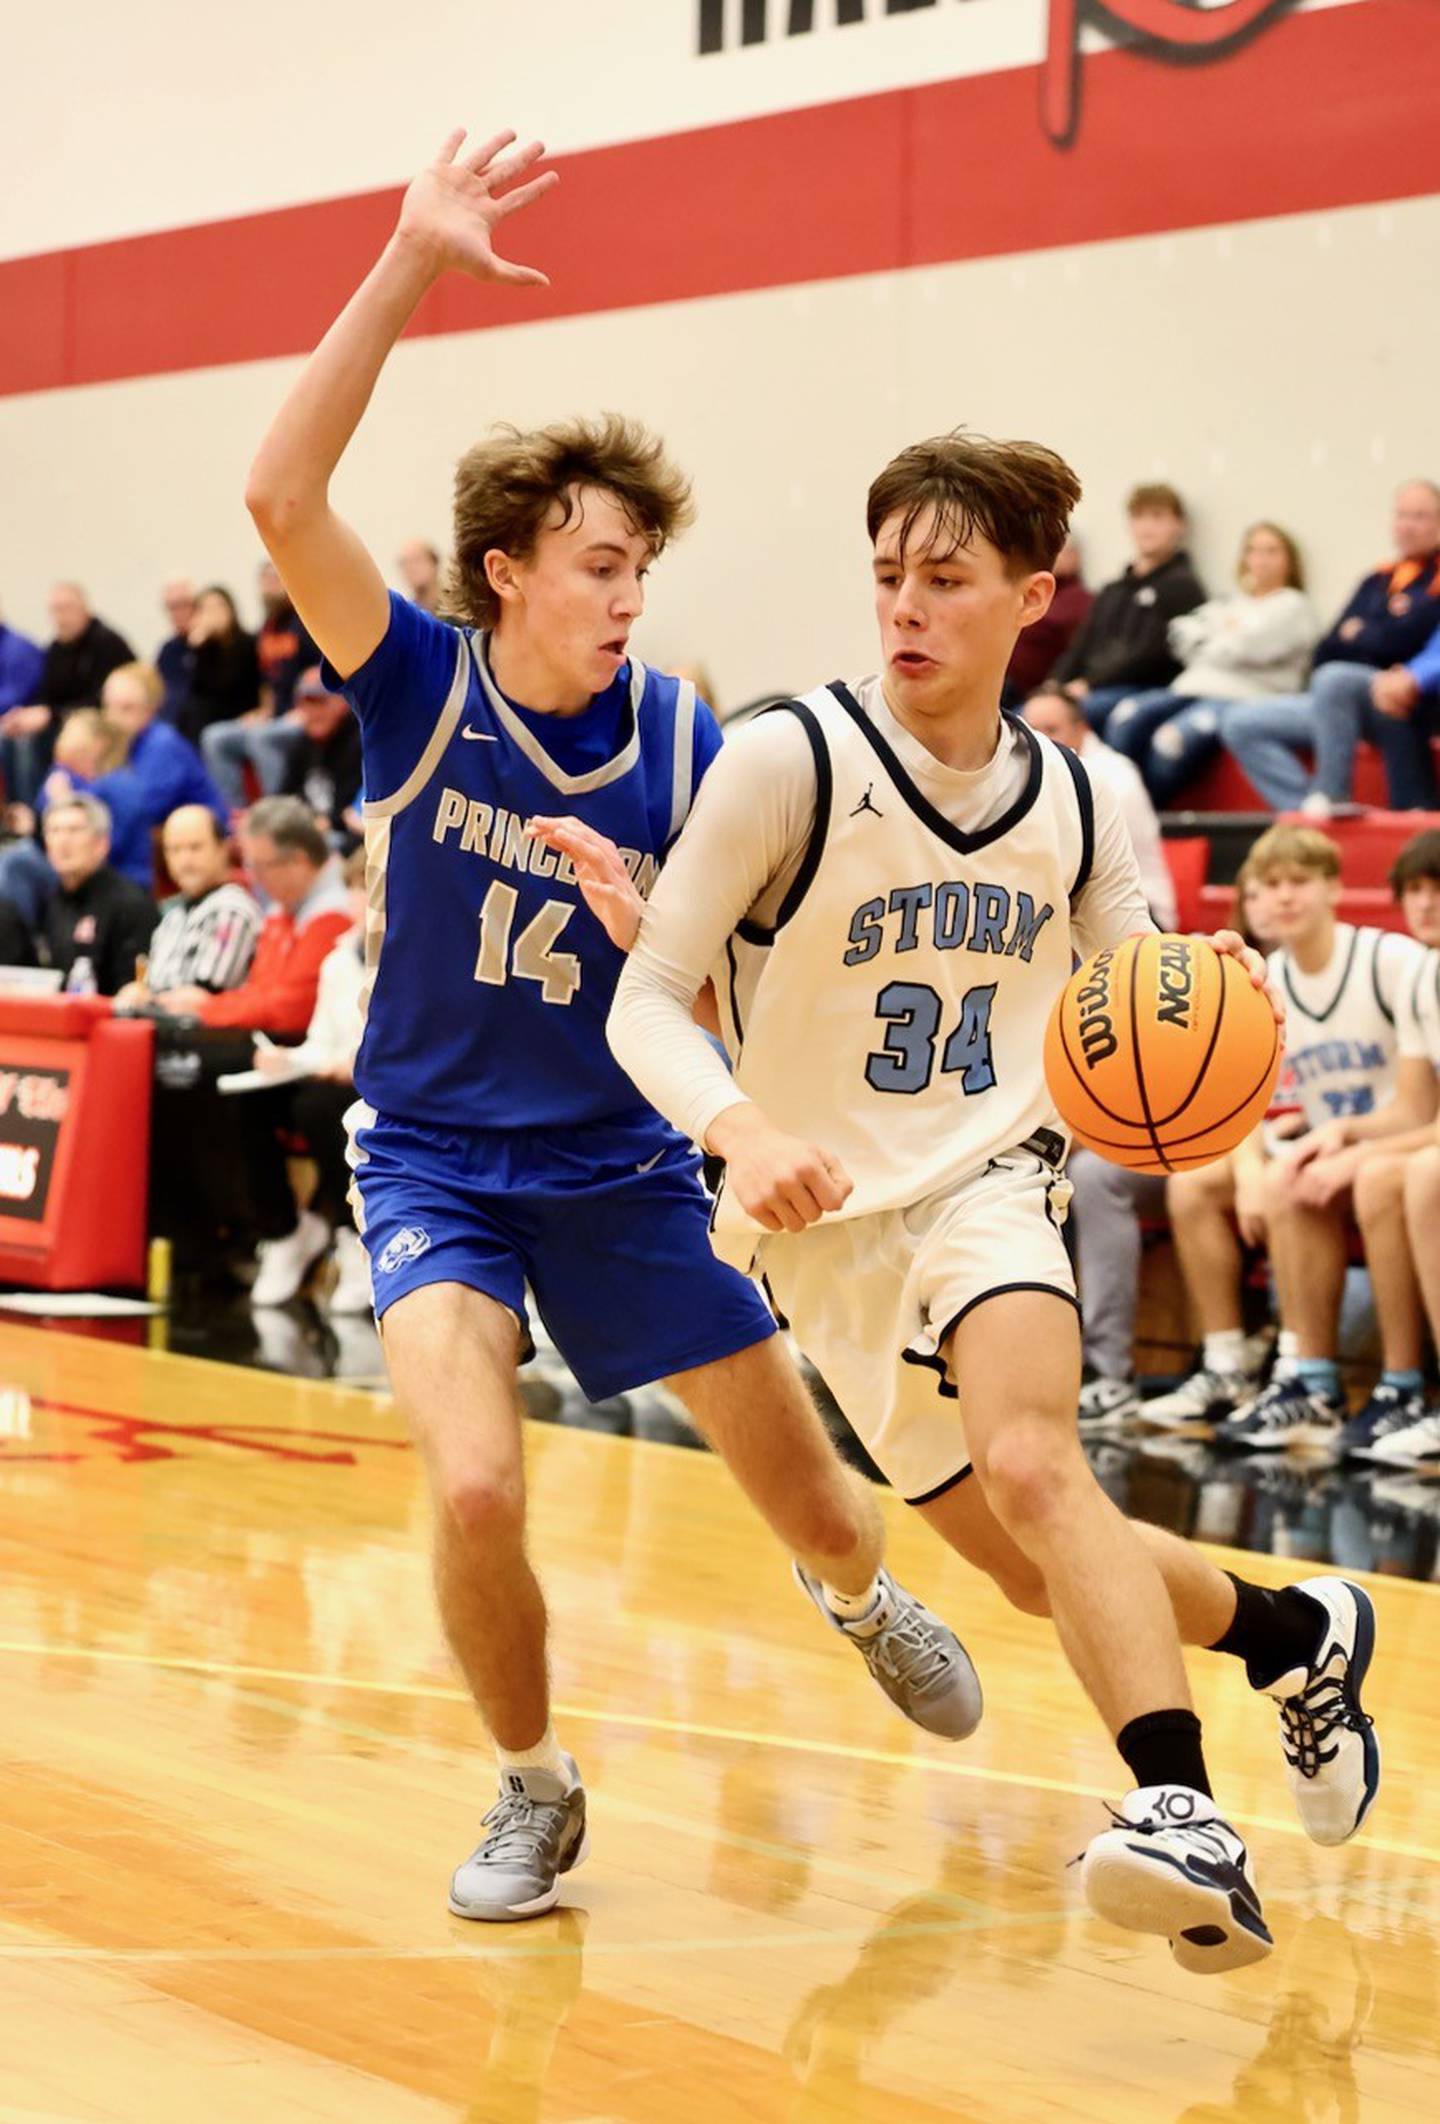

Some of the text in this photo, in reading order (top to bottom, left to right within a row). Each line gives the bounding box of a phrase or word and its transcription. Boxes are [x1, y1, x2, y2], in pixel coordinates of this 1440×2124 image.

[432, 787, 663, 900] PRINCON
[474, 879, 581, 1006] 14
[843, 881, 1054, 967] STORM
[864, 980, 999, 1096] 34
[1157, 942, 1192, 1029] NCAA
